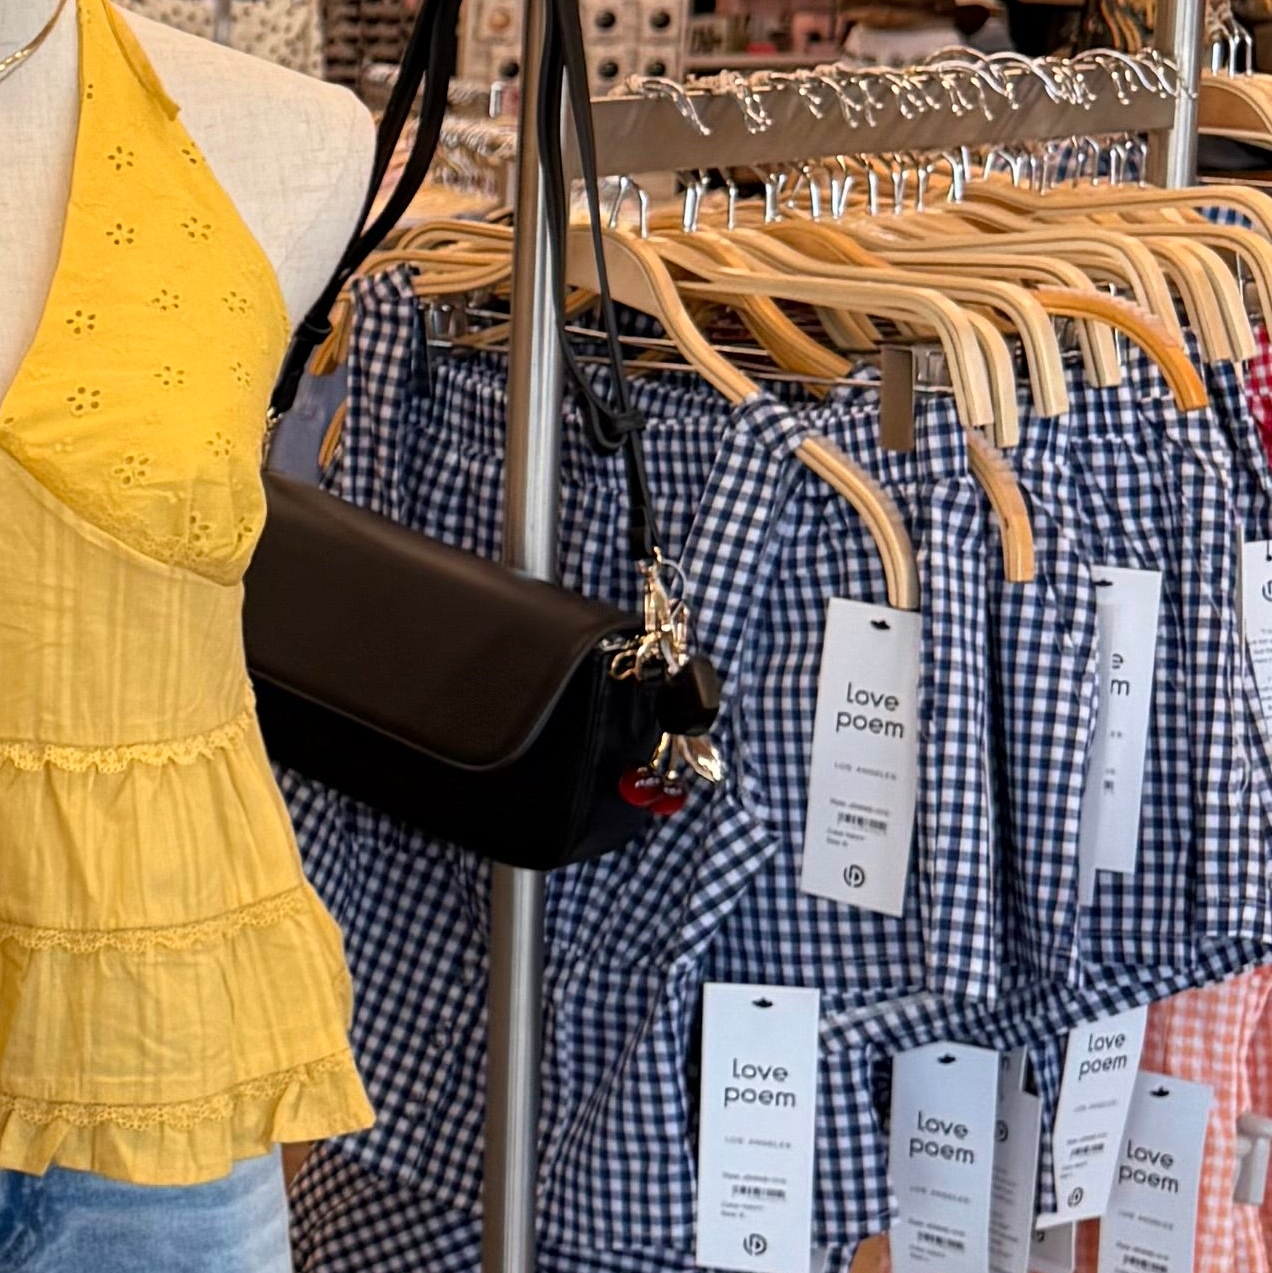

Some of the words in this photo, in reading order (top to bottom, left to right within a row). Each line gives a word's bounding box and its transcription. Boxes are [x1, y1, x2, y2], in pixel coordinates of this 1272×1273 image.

[835, 710, 904, 739] poem
[1078, 1054, 1128, 1081] poem
[724, 1085, 796, 1108] poem
[909, 1137, 975, 1165] poem
[1118, 1164, 1179, 1195] poem
